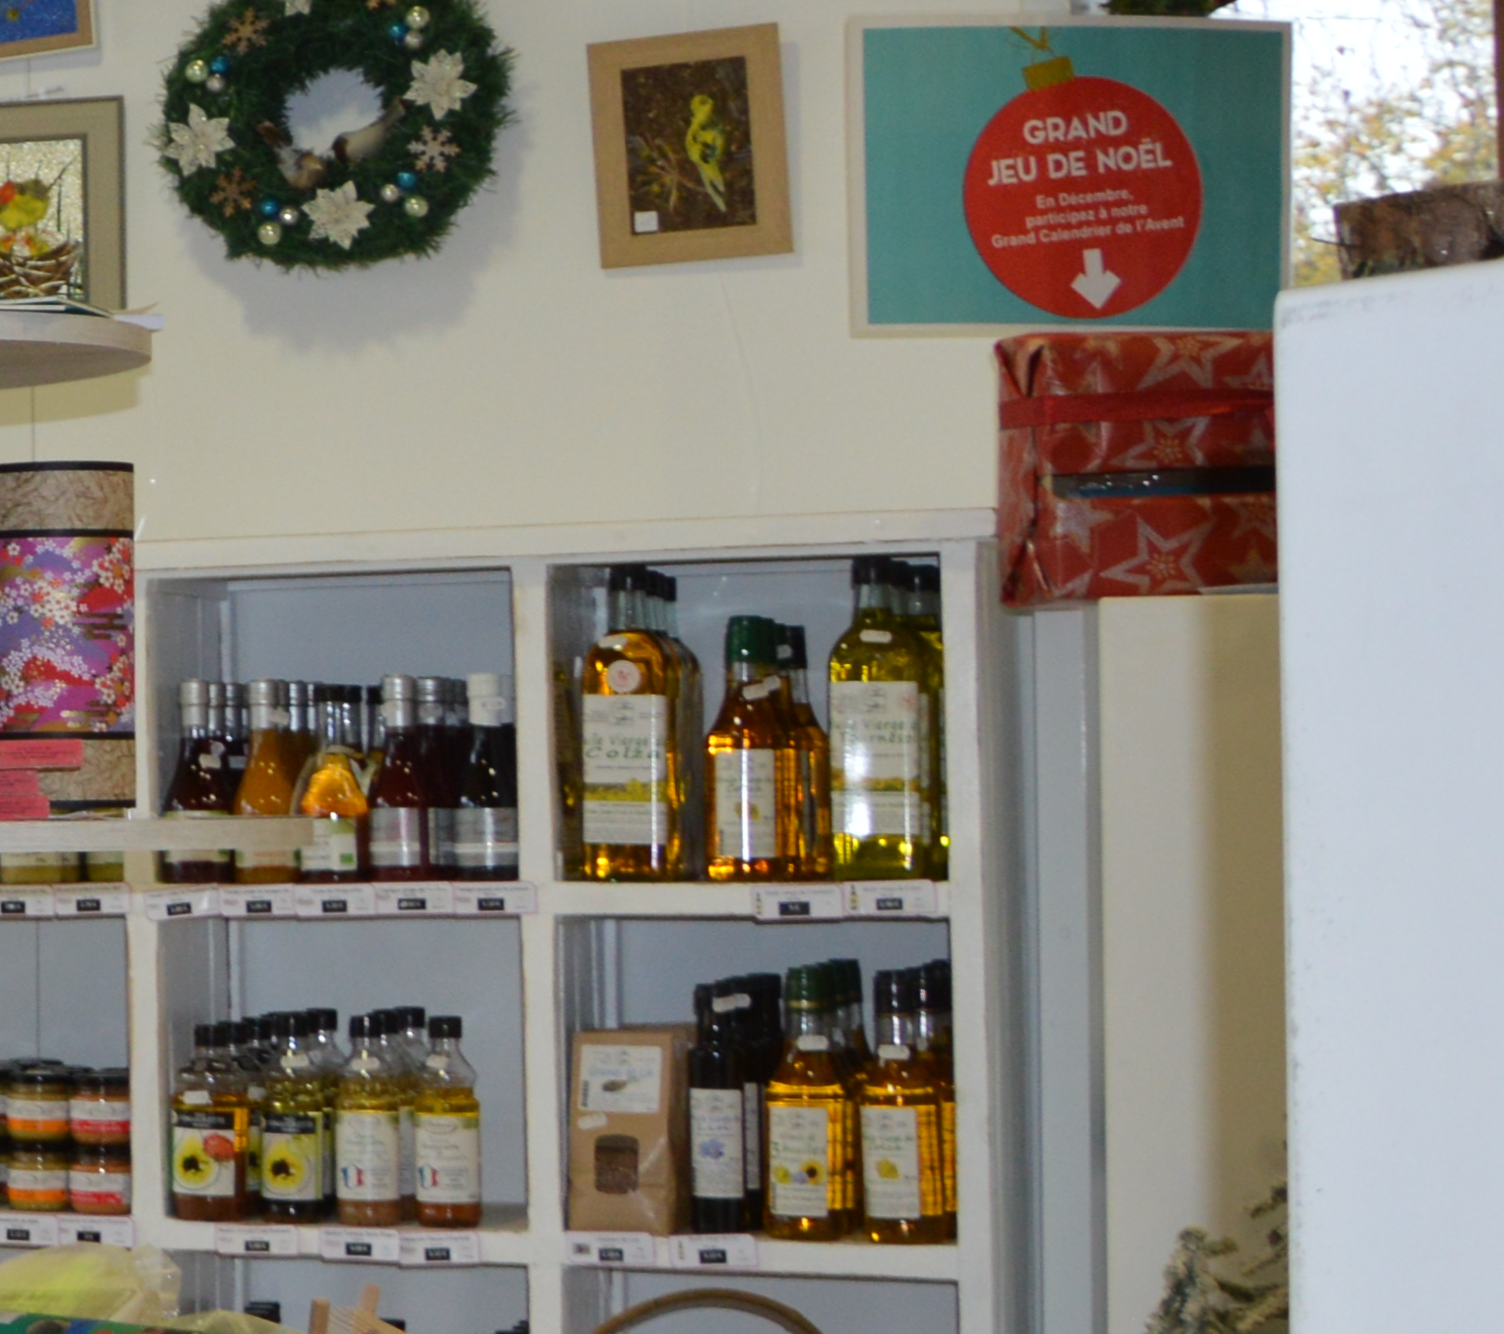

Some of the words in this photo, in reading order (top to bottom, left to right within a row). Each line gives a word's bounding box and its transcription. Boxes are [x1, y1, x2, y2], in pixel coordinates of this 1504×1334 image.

[1022, 109, 1129, 145] GRAND
[987, 155, 1038, 186] JEU
[1046, 150, 1088, 180] DE
[1095, 137, 1173, 174] NOËL
[1025, 208, 1095, 230] participez
[1098, 206, 1108, 219] à
[1110, 203, 1148, 217] notre
[1035, 194, 1056, 209] En
[991, 229, 1036, 249] Grand
[1039, 222, 1112, 244] Calendrier
[1115, 220, 1133, 235] de
[1135, 215, 1186, 232] l'Avent
